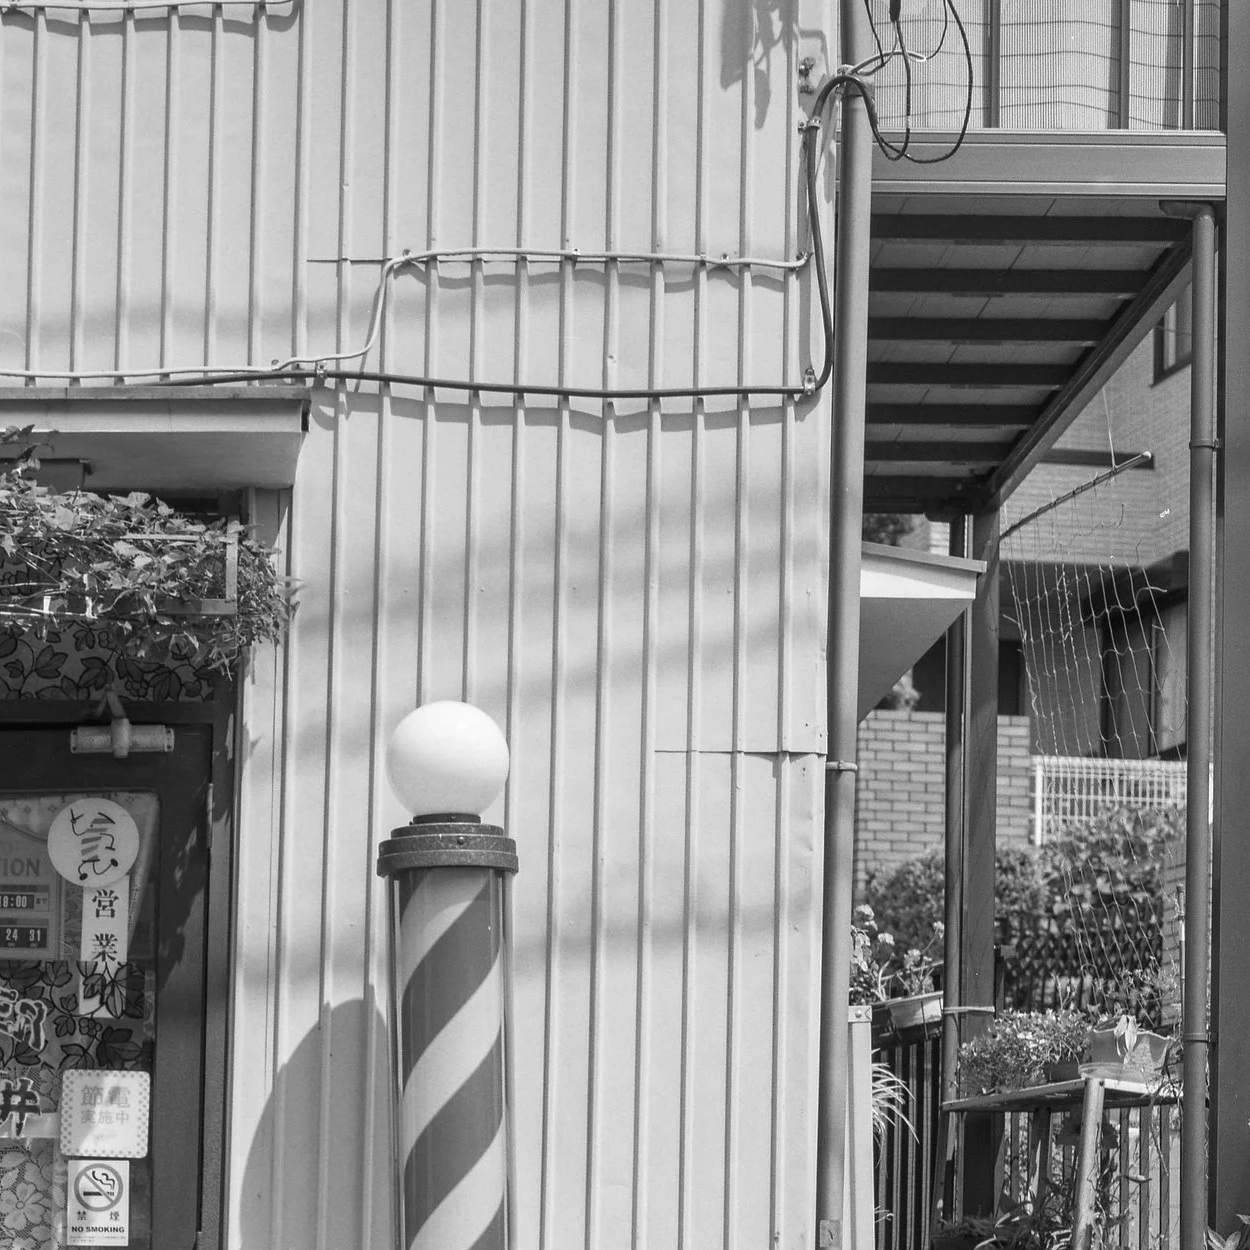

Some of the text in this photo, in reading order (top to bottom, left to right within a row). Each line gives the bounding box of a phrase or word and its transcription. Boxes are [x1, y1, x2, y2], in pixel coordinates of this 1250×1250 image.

[5, 928, 18, 941] 24
[29, 929, 41, 941] 31
[81, 1085, 131, 1108] 節電
[81, 1110, 130, 1125] 実施中
[77, 1210, 120, 1221] 禁煙
